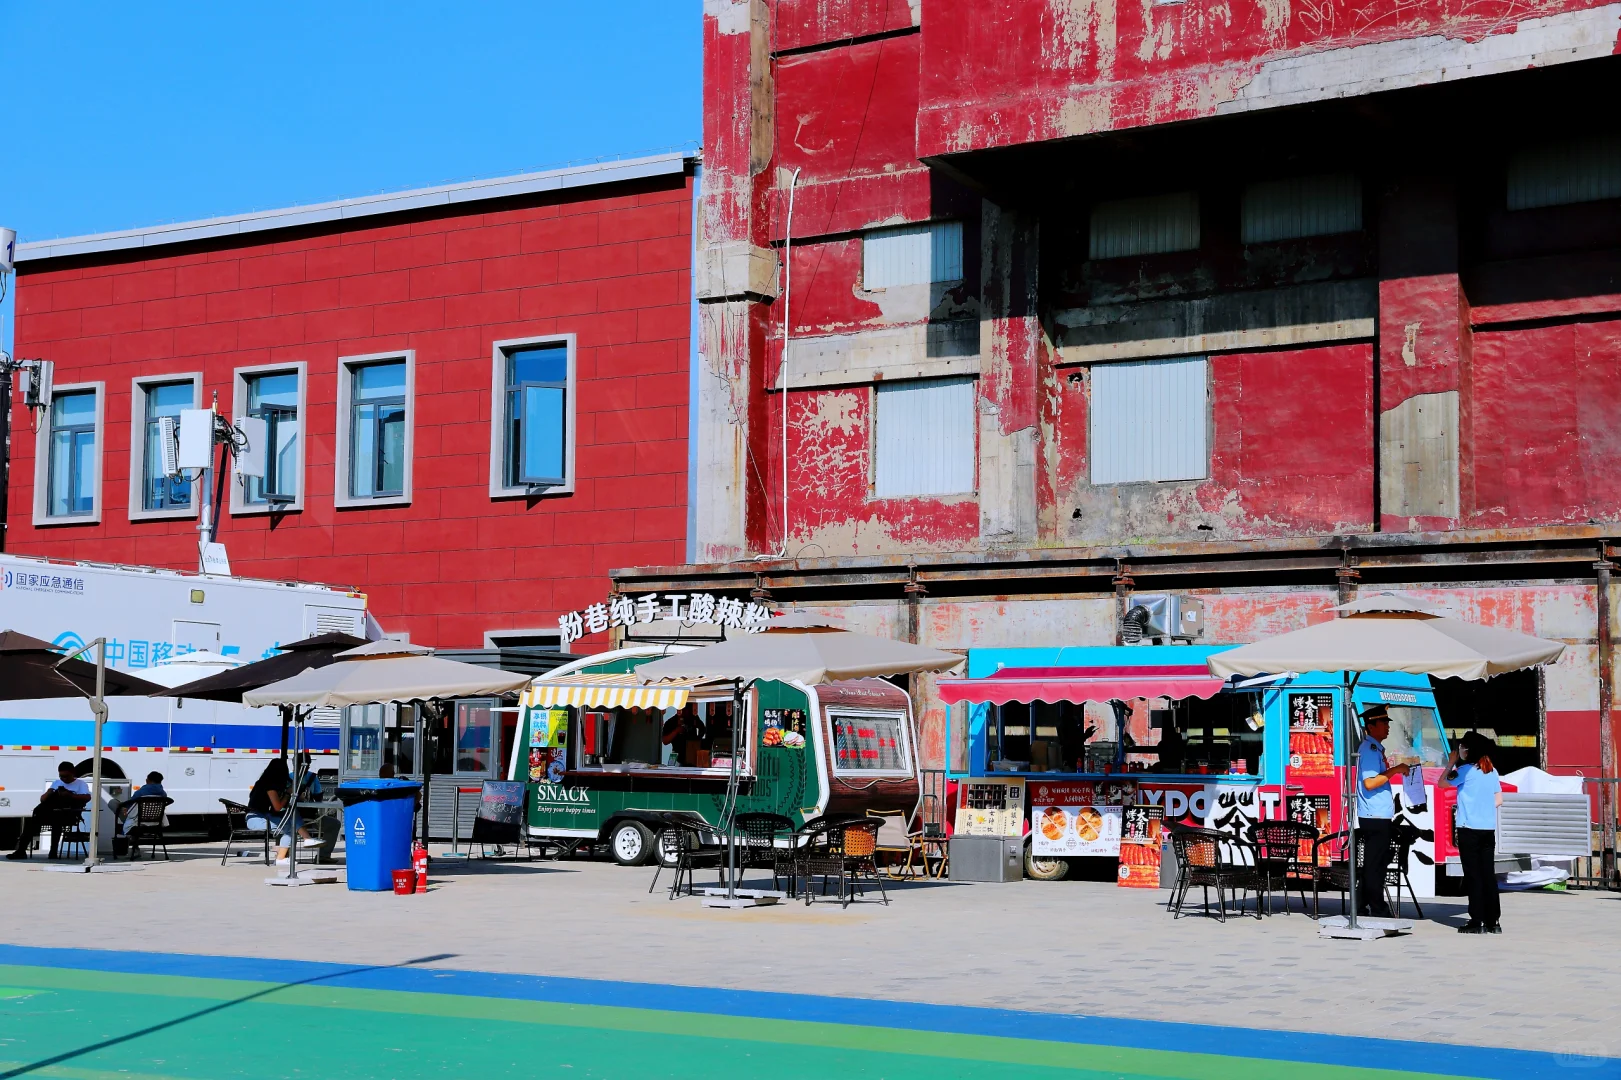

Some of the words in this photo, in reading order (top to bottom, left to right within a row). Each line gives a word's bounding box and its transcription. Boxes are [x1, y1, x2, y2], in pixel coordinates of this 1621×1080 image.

[6, 240, 13, 263] 1
[16, 572, 84, 591] 国家应急通信
[558, 592, 773, 644] 粉巷纯手工酸辣粉
[537, 784, 590, 802] SNACK
[537, 805, 553, 814] Enjoy
[565, 806, 581, 815] happy
